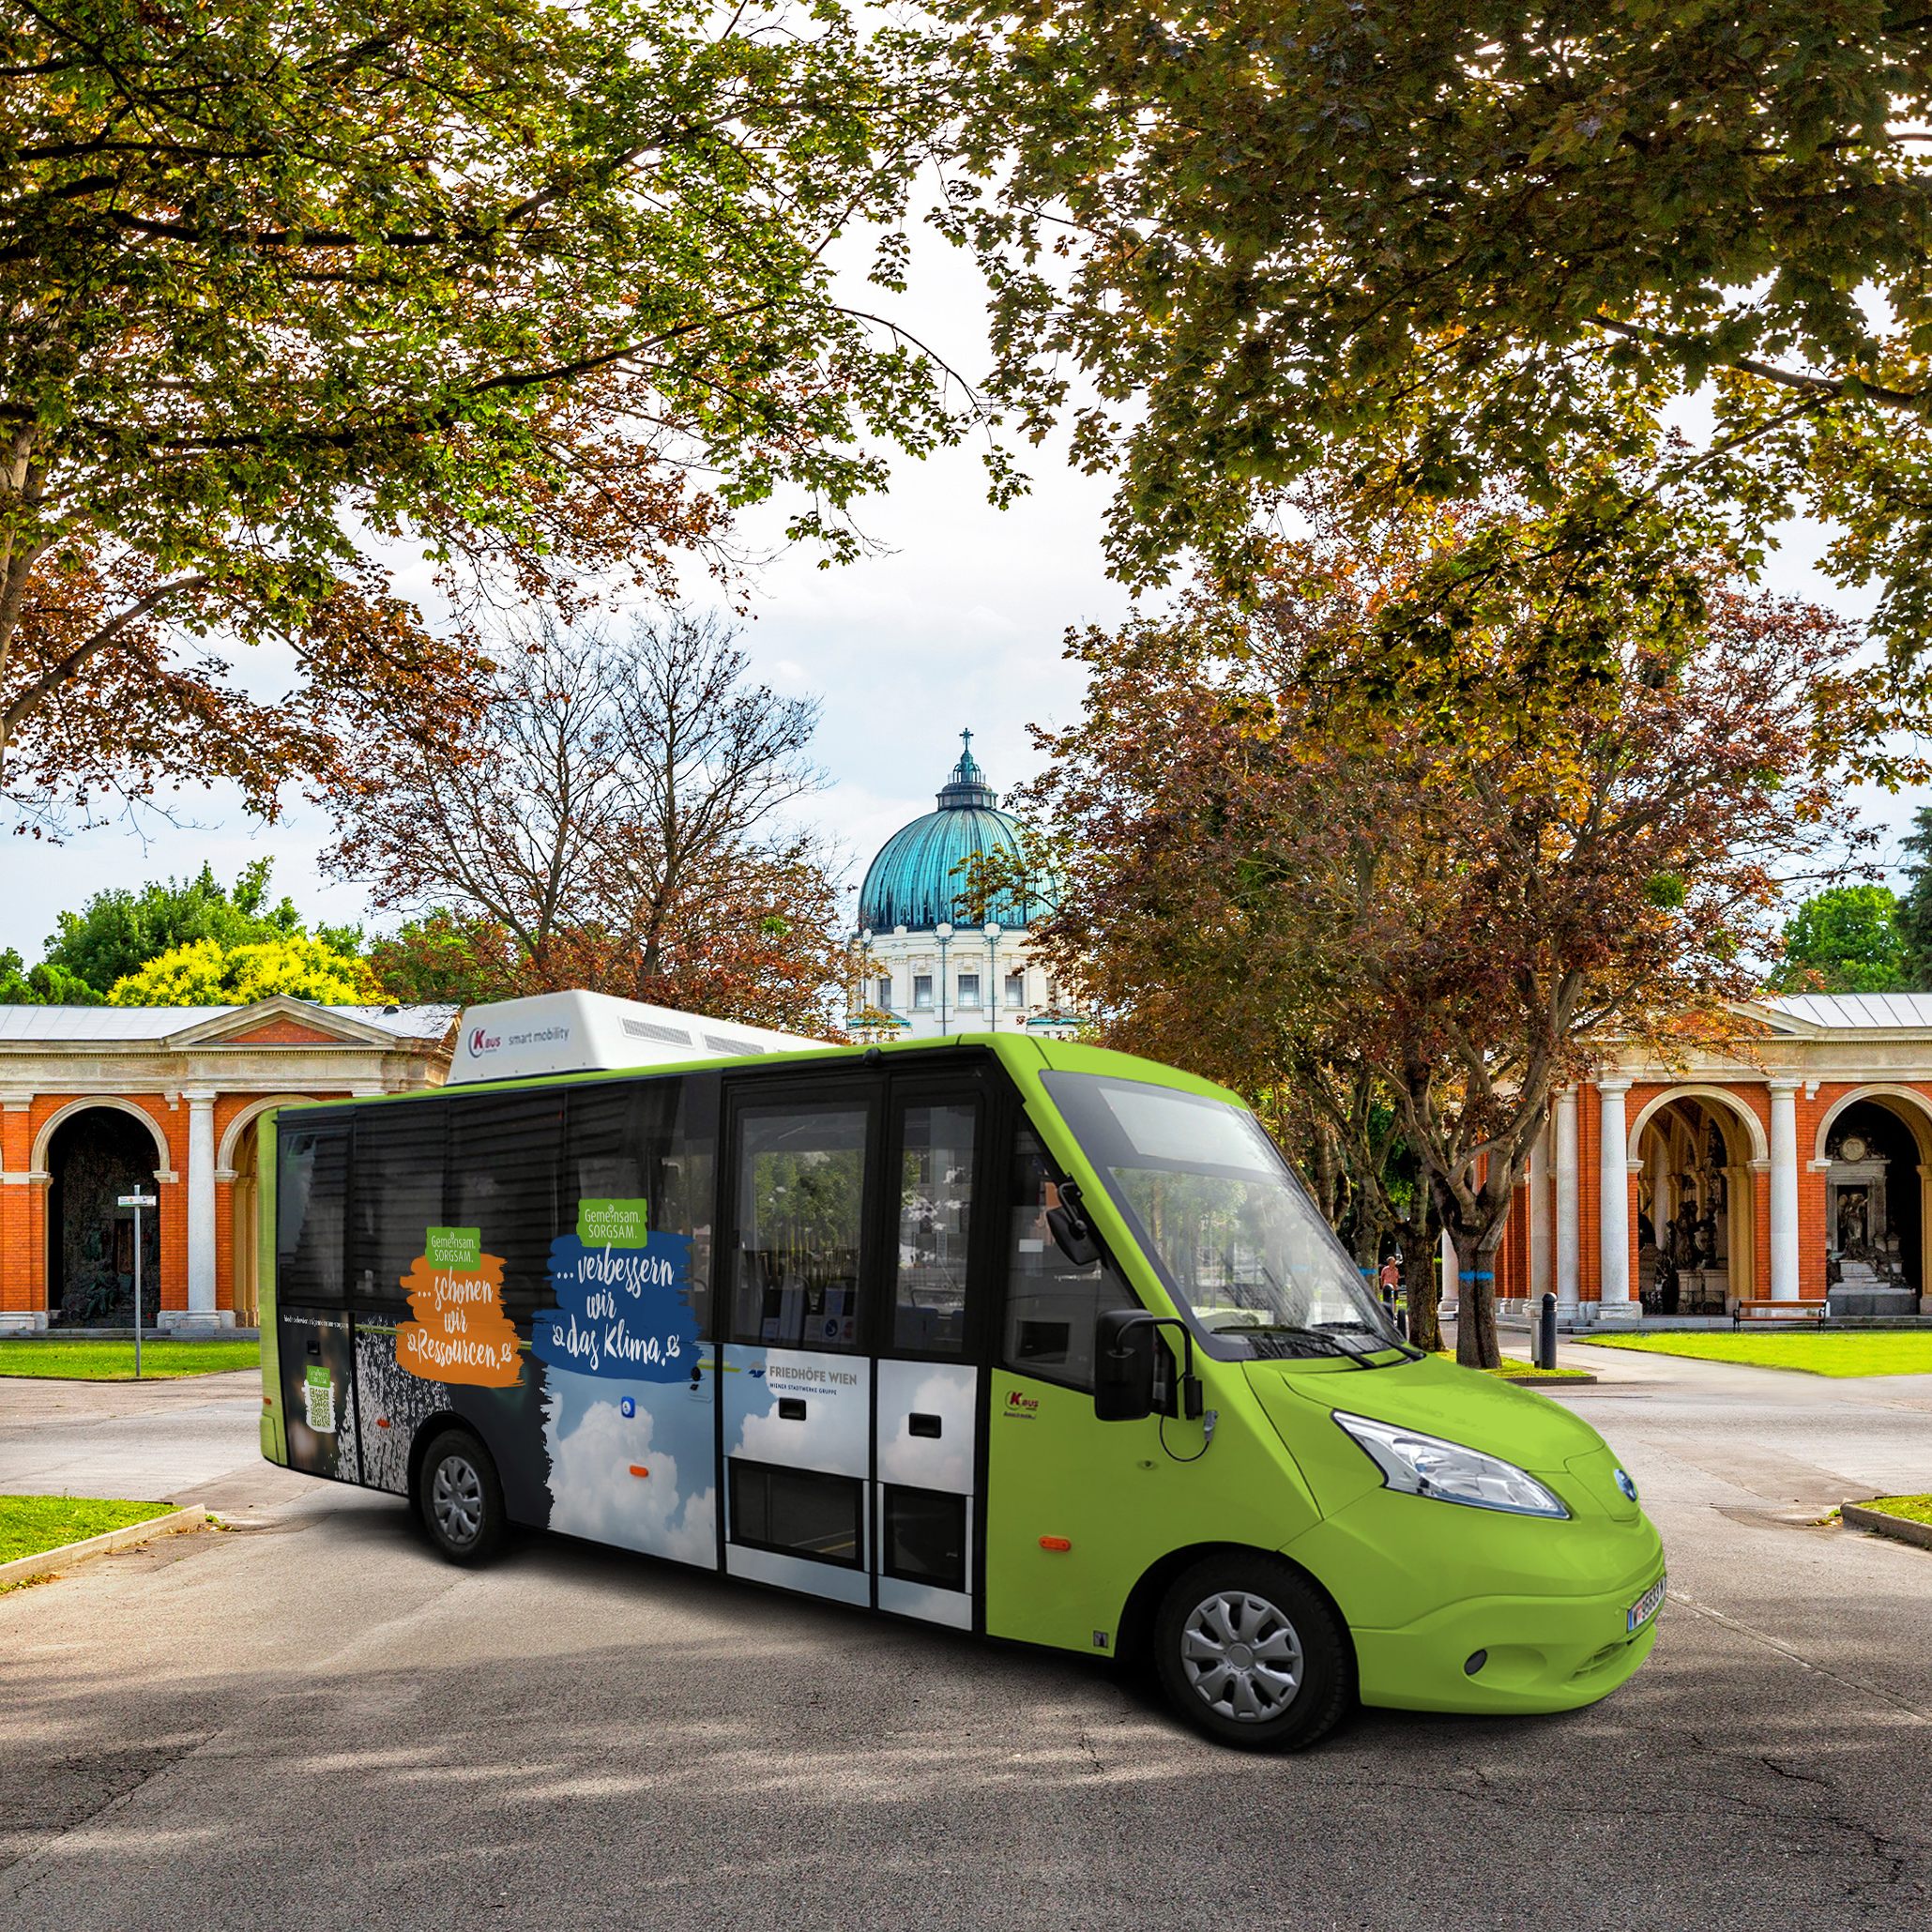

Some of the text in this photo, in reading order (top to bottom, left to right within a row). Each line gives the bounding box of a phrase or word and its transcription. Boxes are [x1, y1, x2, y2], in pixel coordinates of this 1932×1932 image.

[509, 1032, 532, 1045] smart
[534, 1027, 570, 1042] mobility
[585, 1205, 640, 1223] Gemeinsam.
[432, 1232, 475, 1249] Gemeinsam.
[588, 1225, 638, 1239] SORGSAM.
[434, 1249, 474, 1263] SORGSAM.
[586, 1288, 617, 1320] wir
[444, 1307, 467, 1333] wir
[418, 1329, 500, 1370] Ressourcen.
[567, 1314, 666, 1371] das Klima.
[769, 1365, 858, 1385] FRIEDHÖFE WIEN
[788, 1385, 817, 1393] STADTWERKE
